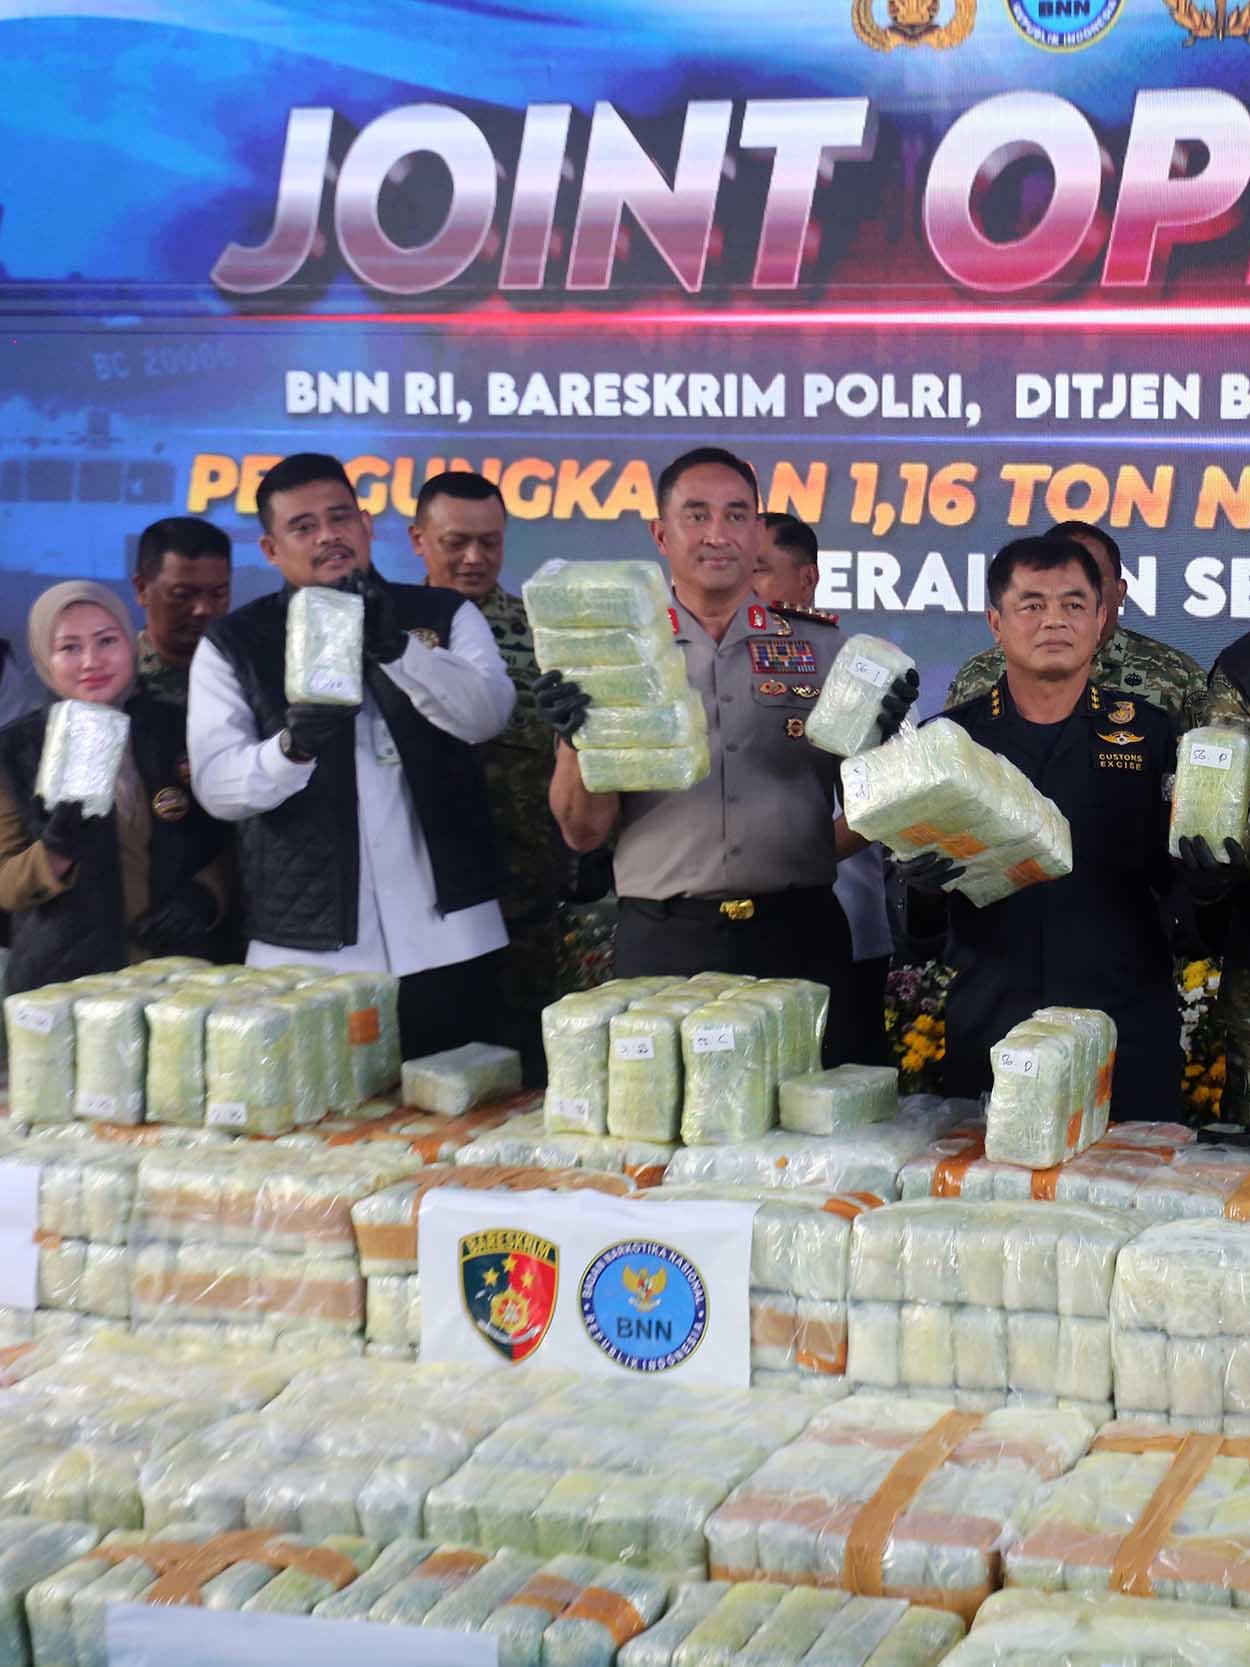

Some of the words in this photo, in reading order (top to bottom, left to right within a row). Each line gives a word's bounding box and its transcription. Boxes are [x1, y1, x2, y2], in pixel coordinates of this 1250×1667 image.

[210, 97, 870, 295] JOINT
[286, 371, 389, 414] BNN
[405, 371, 472, 423] RI,
[488, 372, 786, 418] BARESKRIM
[804, 372, 981, 428] POLRI,
[1016, 373, 1200, 420] DITJEN
[849, 461, 978, 536] 1,16
[1000, 463, 1174, 528] TON
[617, 1317, 672, 1342] BNN
